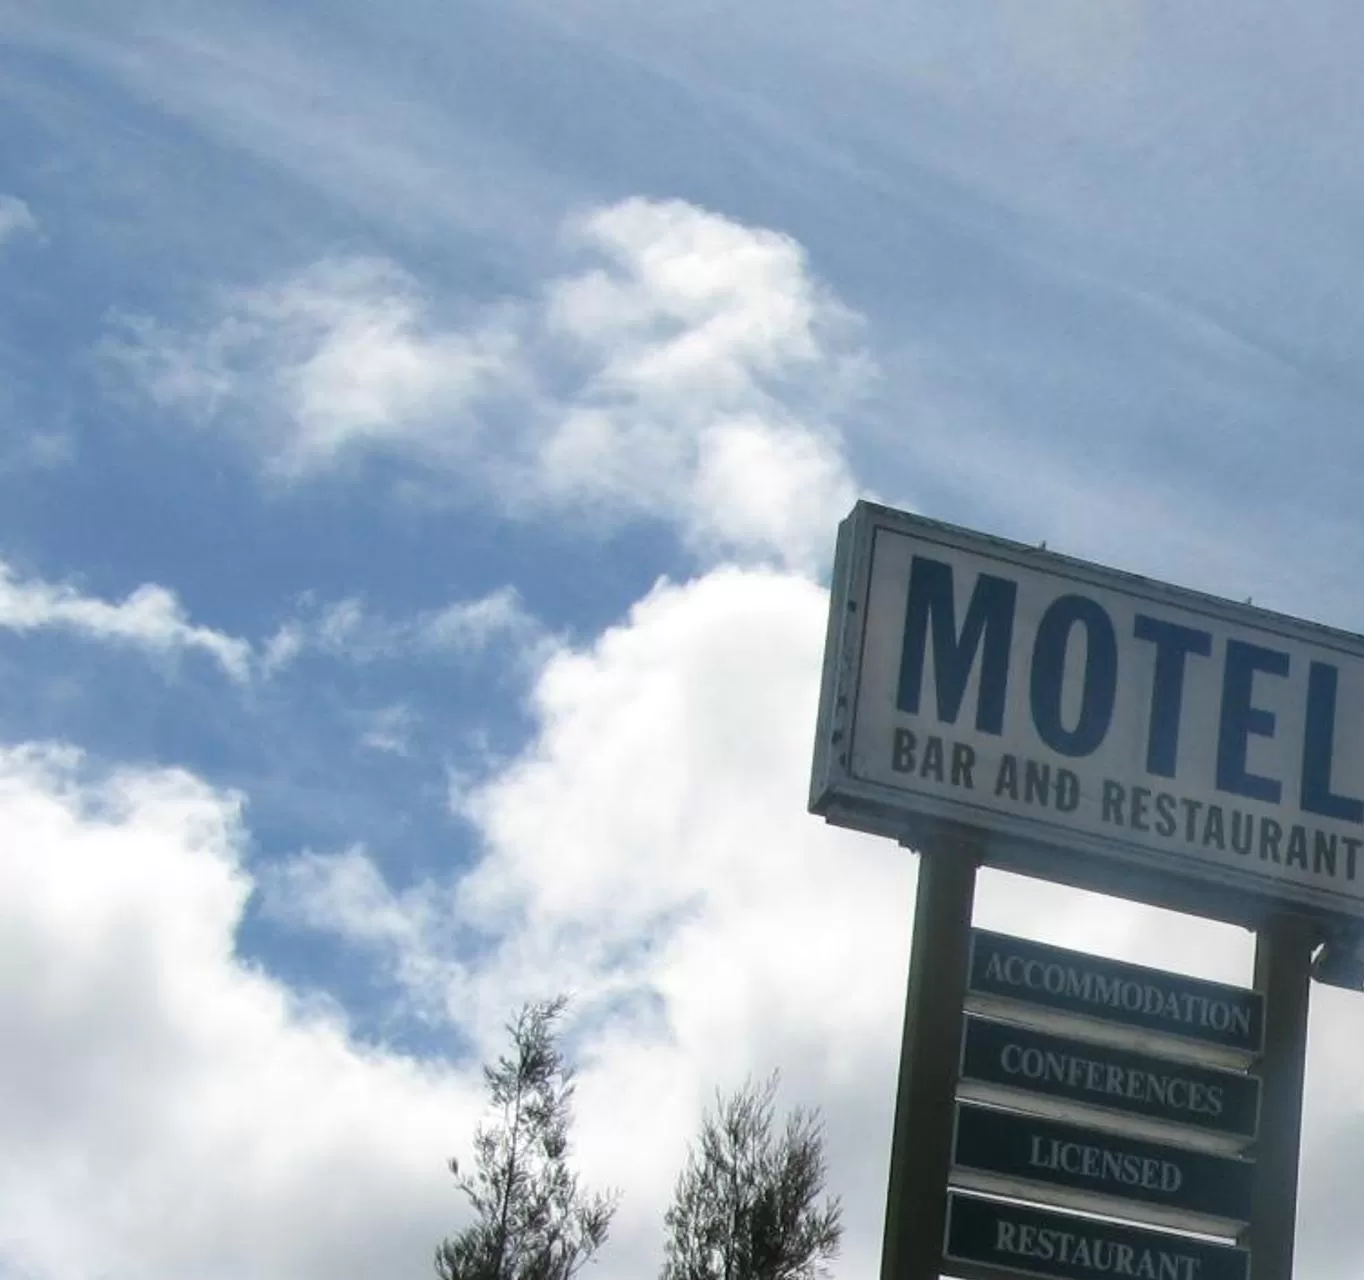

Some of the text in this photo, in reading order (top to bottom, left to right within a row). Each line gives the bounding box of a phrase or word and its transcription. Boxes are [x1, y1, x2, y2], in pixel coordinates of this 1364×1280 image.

[891, 727, 1364, 882] BAR AND RESTAURANT
[984, 951, 1253, 1037] ACCOMMODATION
[1000, 1043, 1224, 1117] CONFERENCES
[1028, 1135, 1183, 1193] LICENSED
